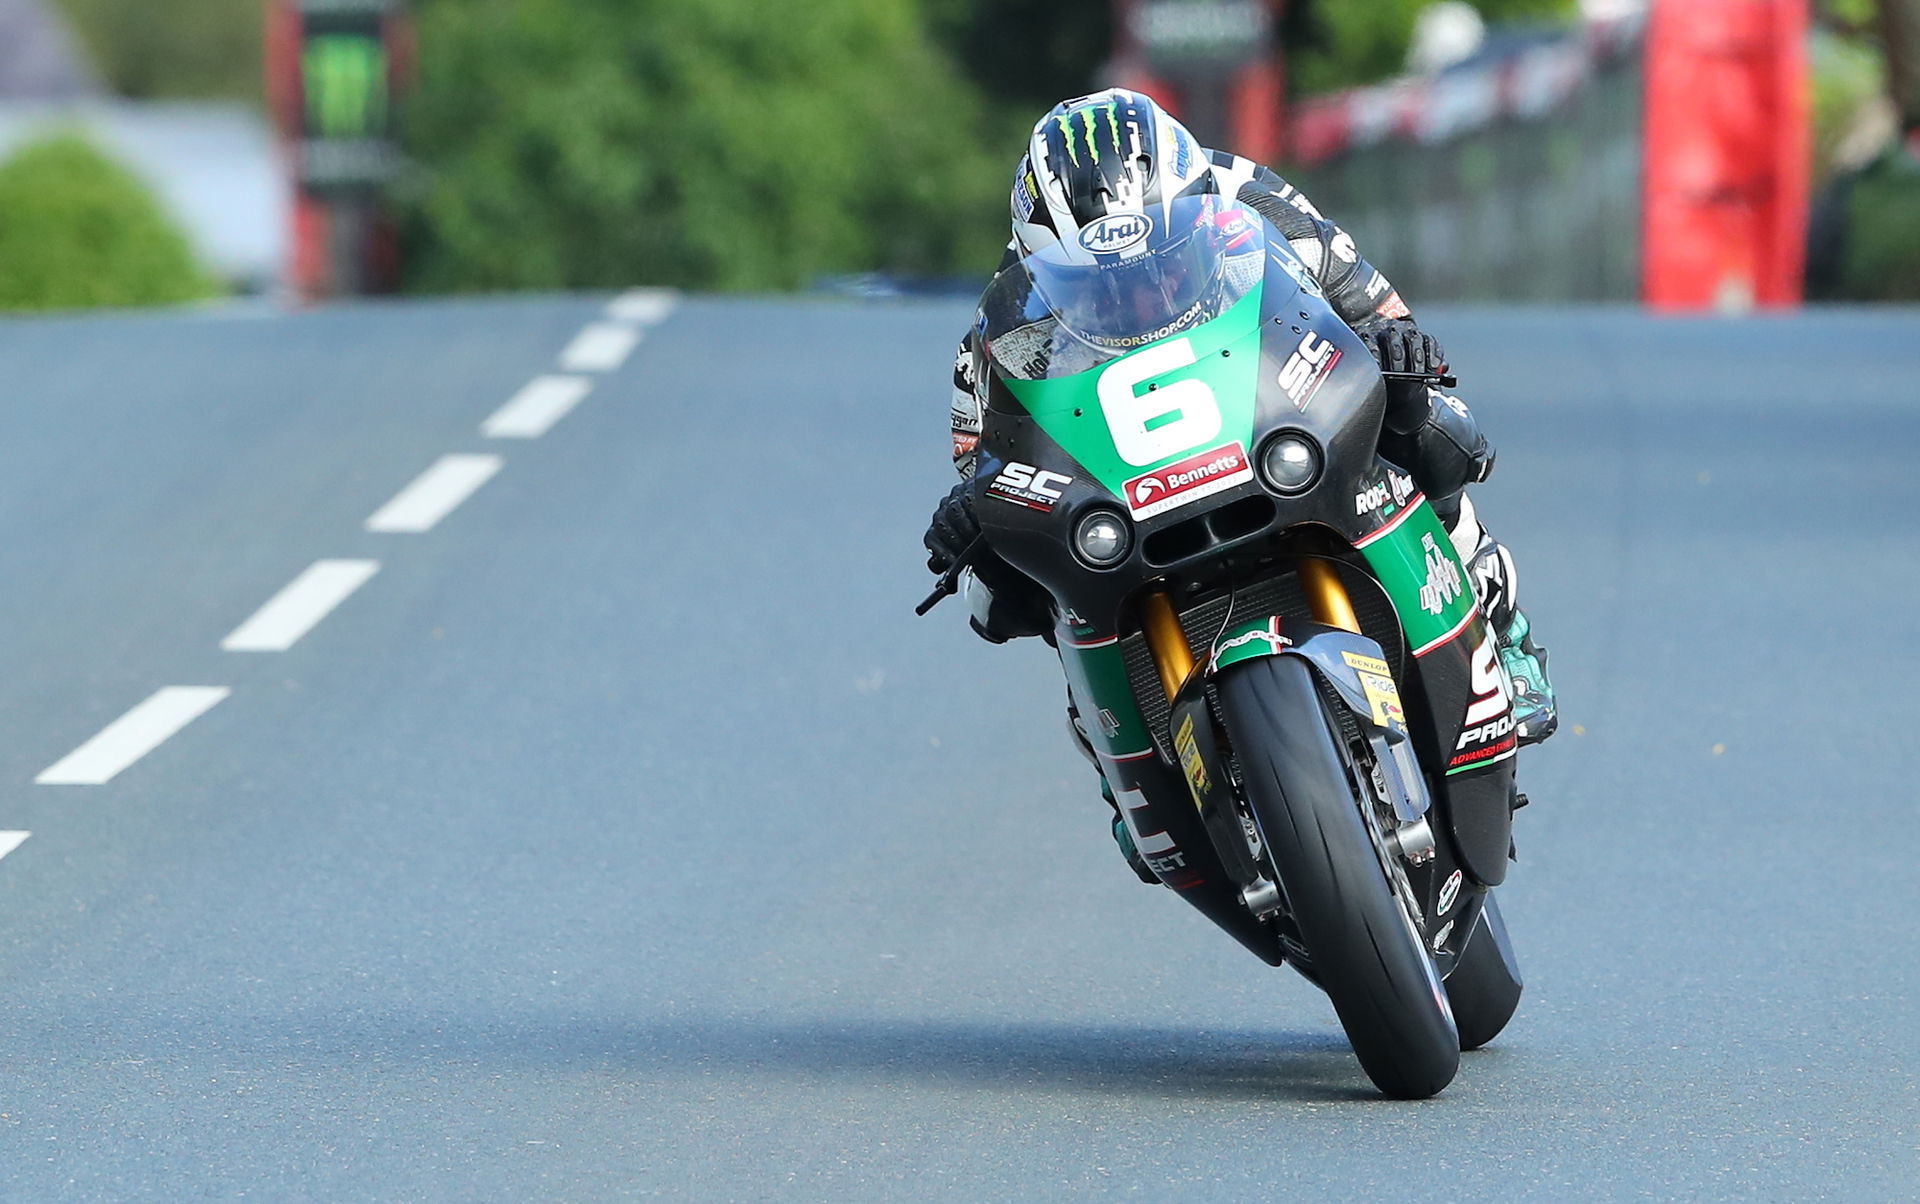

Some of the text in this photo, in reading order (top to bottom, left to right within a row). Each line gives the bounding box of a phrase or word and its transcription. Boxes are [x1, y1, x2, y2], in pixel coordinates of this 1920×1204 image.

[1083, 217, 1142, 247] Arai
[1101, 238, 1132, 249] HELMET
[1099, 249, 1157, 271] PARAMOUNT
[1079, 301, 1202, 347] THEVISORSHOP.COM
[1278, 331, 1331, 400] SC
[1293, 343, 1335, 406] PROJECT
[1097, 337, 1222, 467] 6
[995, 461, 1073, 499] SC
[1166, 456, 1239, 489] Bennetts
[990, 483, 1058, 506] PROJECT
[1350, 658, 1388, 672] DUNLOP
